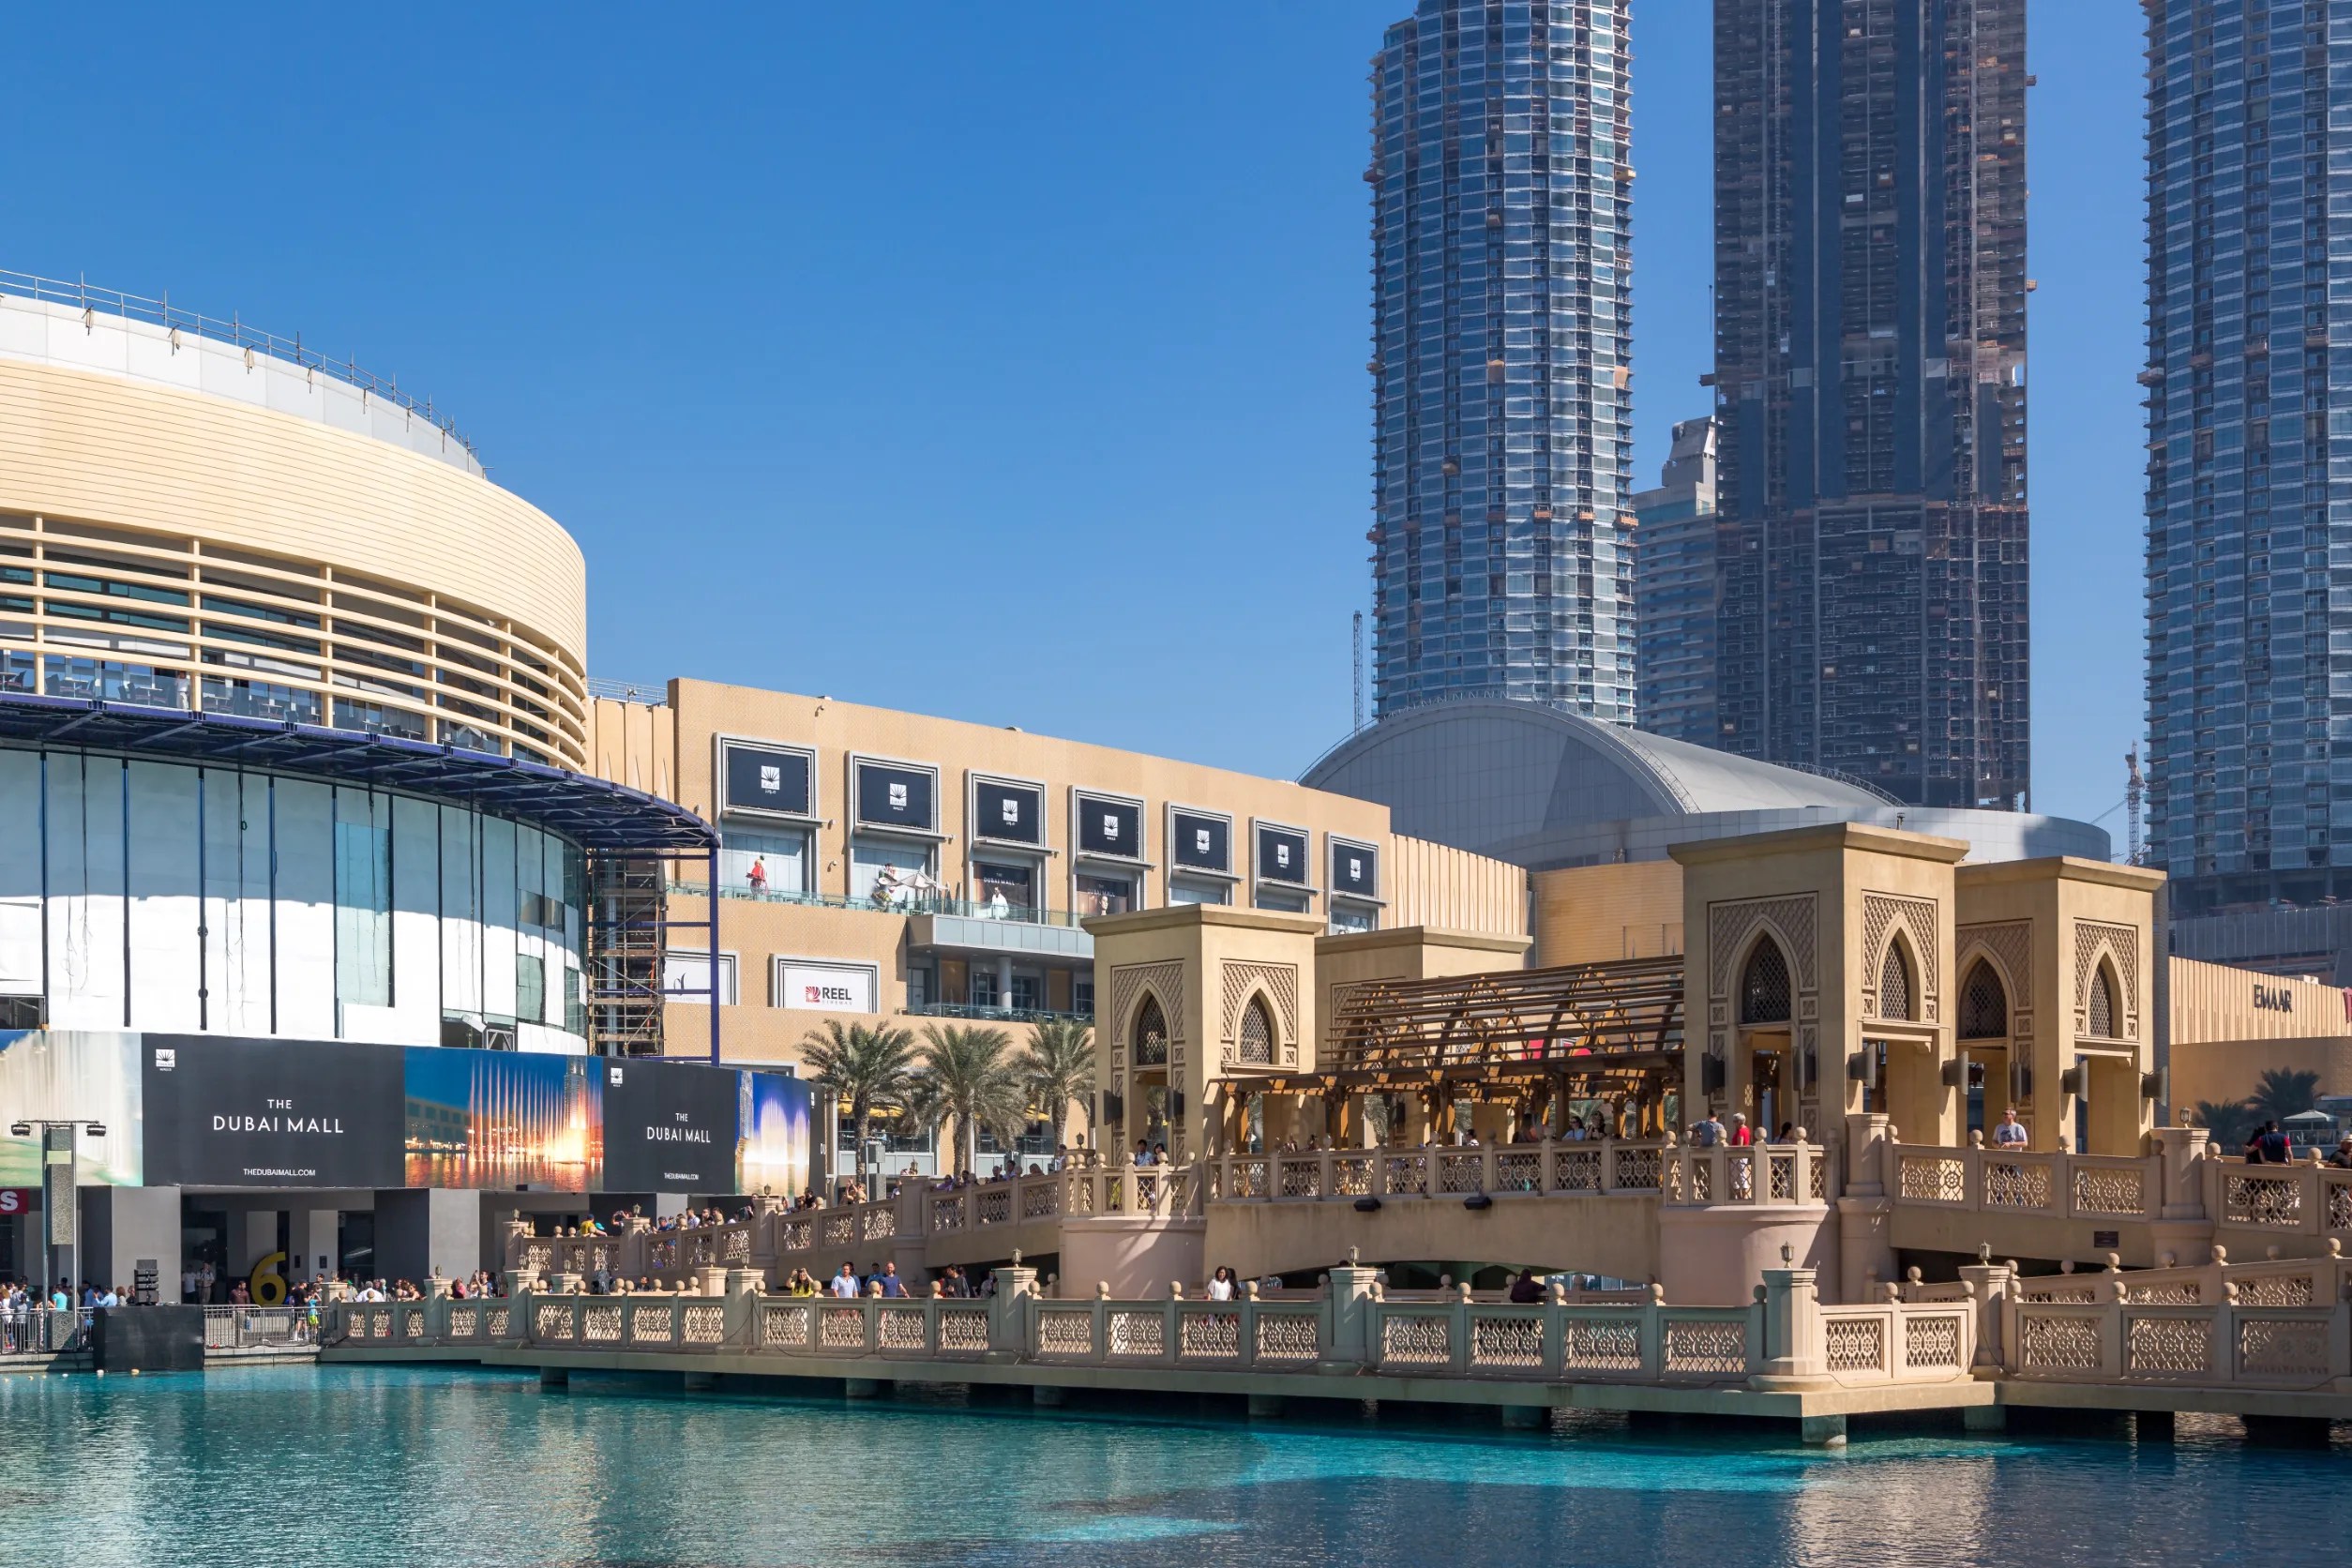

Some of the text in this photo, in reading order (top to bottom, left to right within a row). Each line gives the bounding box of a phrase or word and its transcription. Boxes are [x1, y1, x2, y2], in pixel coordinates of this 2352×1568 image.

[822, 987, 852, 1001] REEL
[2254, 984, 2293, 1013] EMAAR
[267, 1099, 293, 1109] THE
[675, 1112, 688, 1122] THE
[213, 1115, 344, 1134] DUBAI MALL
[646, 1126, 711, 1143] DUBAI MALL
[243, 1168, 316, 1177] THEDUBAIMALL.COM
